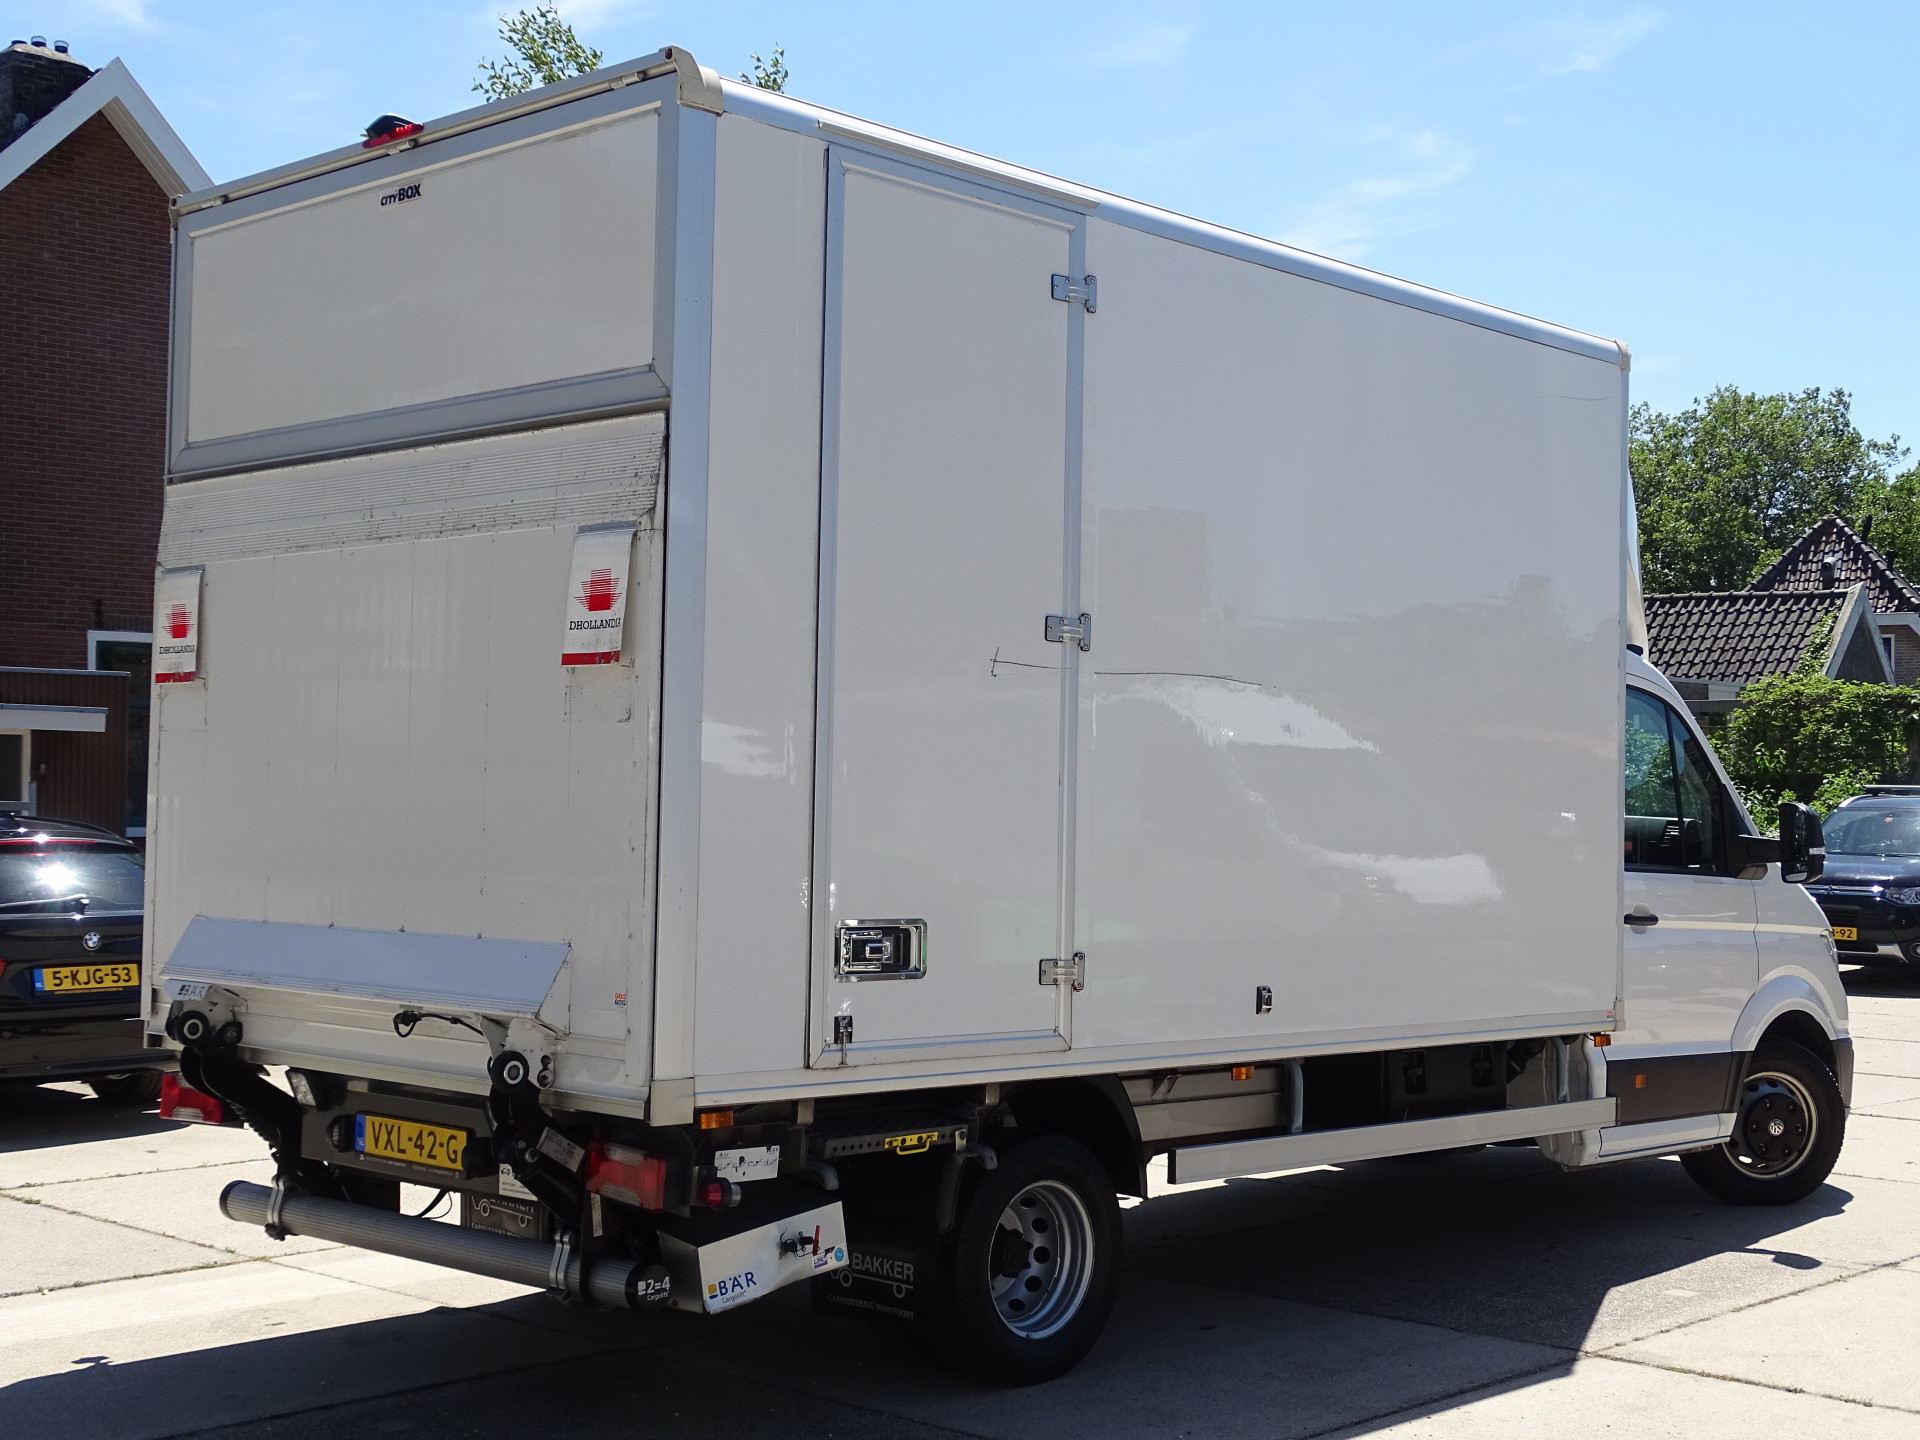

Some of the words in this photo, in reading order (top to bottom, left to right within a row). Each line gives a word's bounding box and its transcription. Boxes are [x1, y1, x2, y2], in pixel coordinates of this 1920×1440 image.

[52, 967, 132, 987] 5-KJG-53
[371, 1121, 458, 1164] VXL-42-G
[851, 1252, 914, 1282] BAKKER
[718, 1271, 757, 1296] BÄR
[827, 1294, 875, 1310] CARROSSERIE
